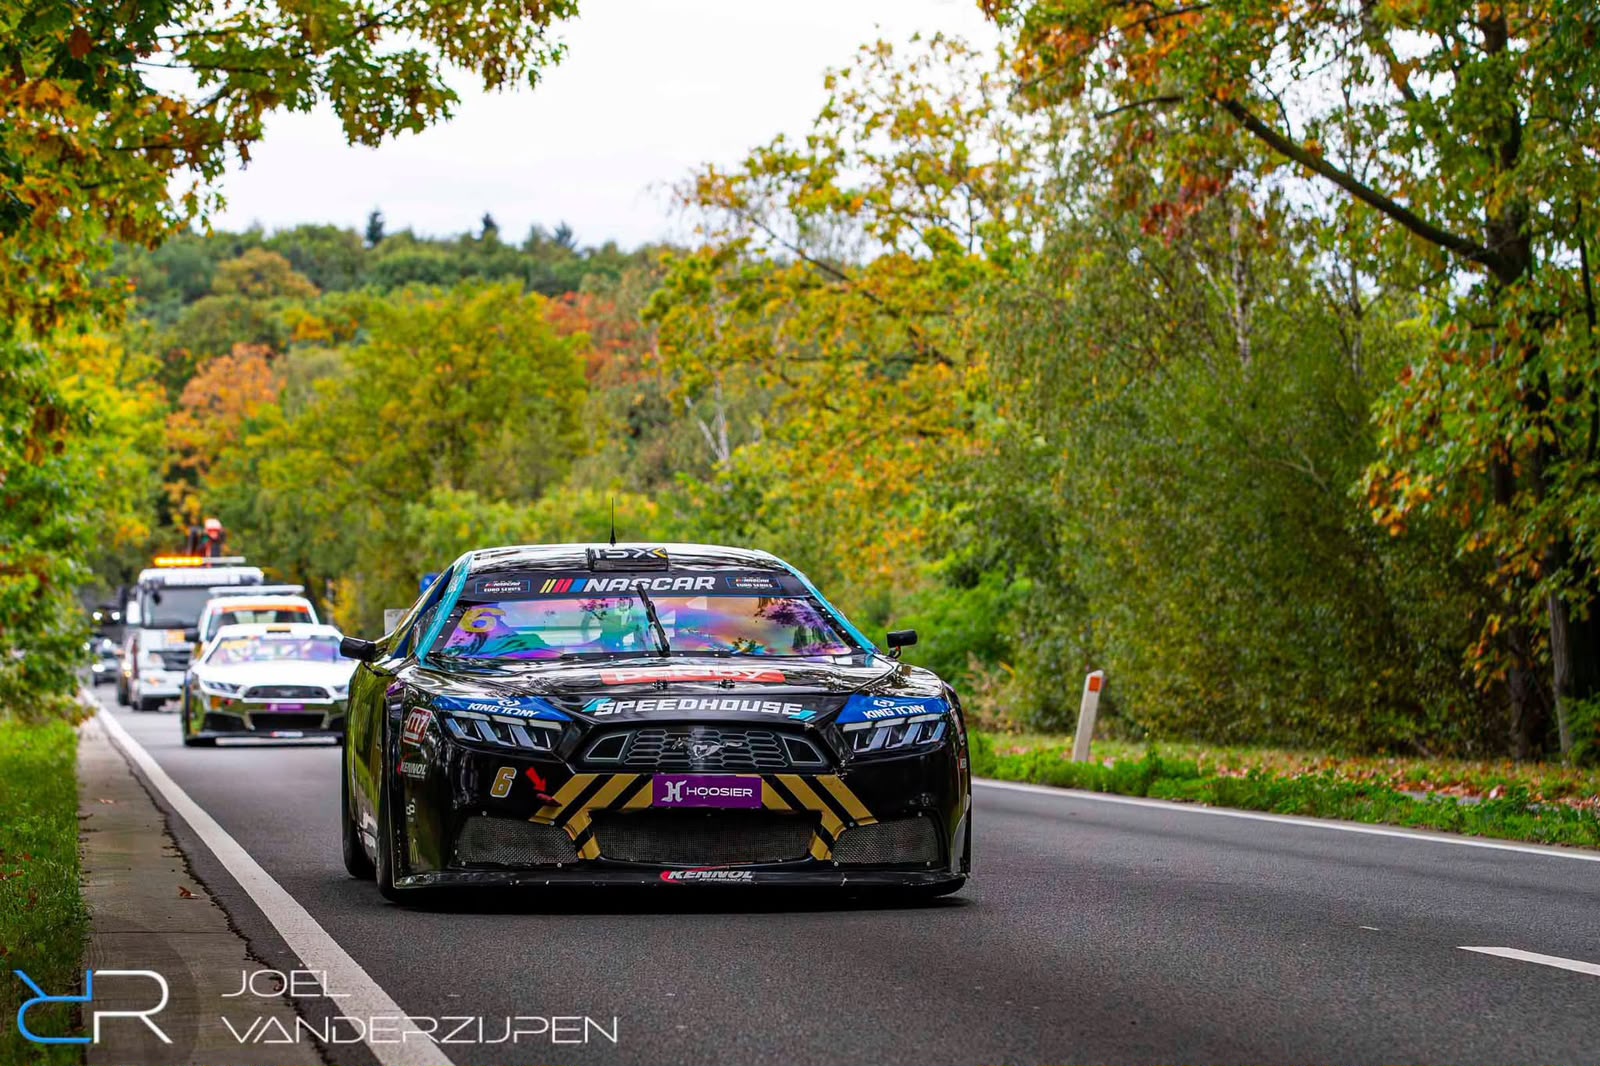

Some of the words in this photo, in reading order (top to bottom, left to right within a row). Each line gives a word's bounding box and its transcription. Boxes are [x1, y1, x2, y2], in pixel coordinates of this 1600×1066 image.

[583, 577, 716, 592] NASCAR
[460, 608, 506, 633] 6
[467, 702, 499, 713] KING
[501, 706, 541, 718] TONY
[594, 699, 803, 716] SPEEDHOUSE
[863, 708, 896, 719] KING
[893, 704, 927, 716] TONY
[400, 762, 427, 775] KENNOL
[490, 766, 517, 798] 6
[686, 786, 753, 797] HOOSIER
[668, 870, 754, 880] KENNOL
